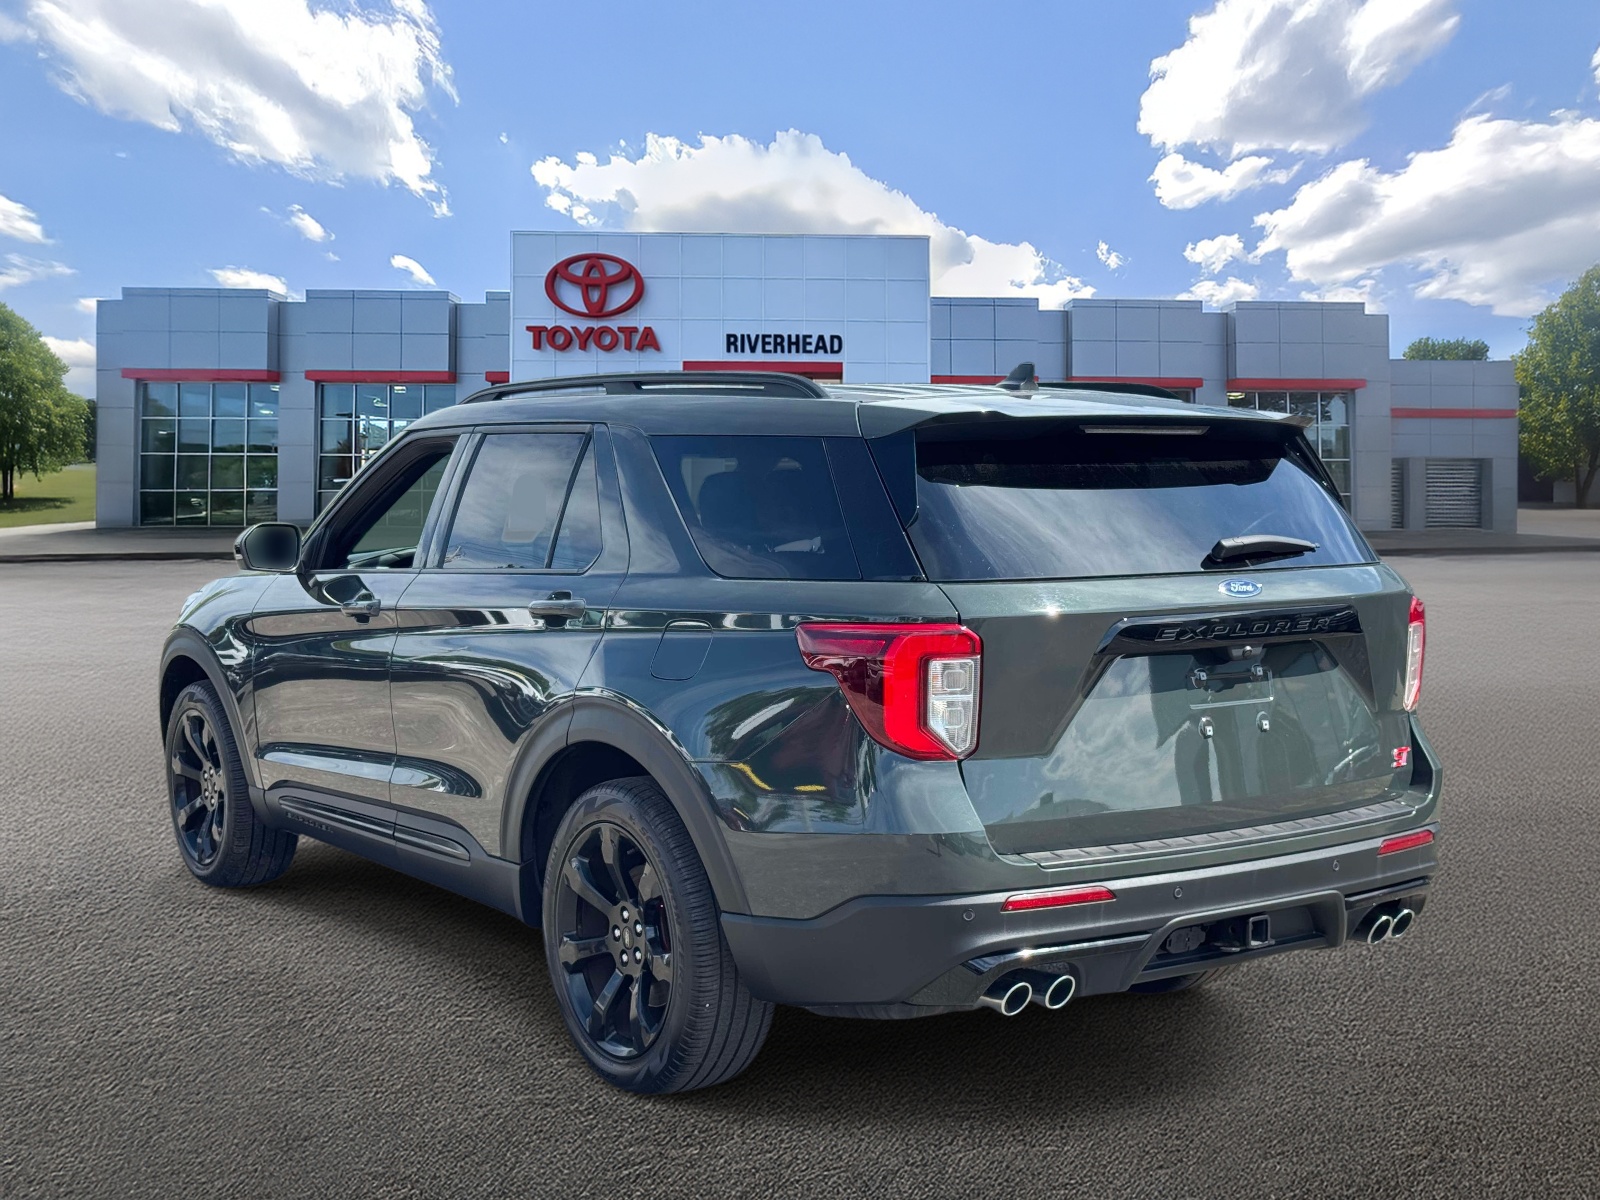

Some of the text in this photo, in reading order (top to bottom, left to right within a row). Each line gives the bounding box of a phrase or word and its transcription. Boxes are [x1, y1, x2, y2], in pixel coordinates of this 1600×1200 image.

[526, 325, 661, 352] TOYOTA
[726, 333, 843, 354] RIVERHEAD
[1230, 581, 1255, 592] Ford
[1154, 617, 1331, 642] EXPLORER
